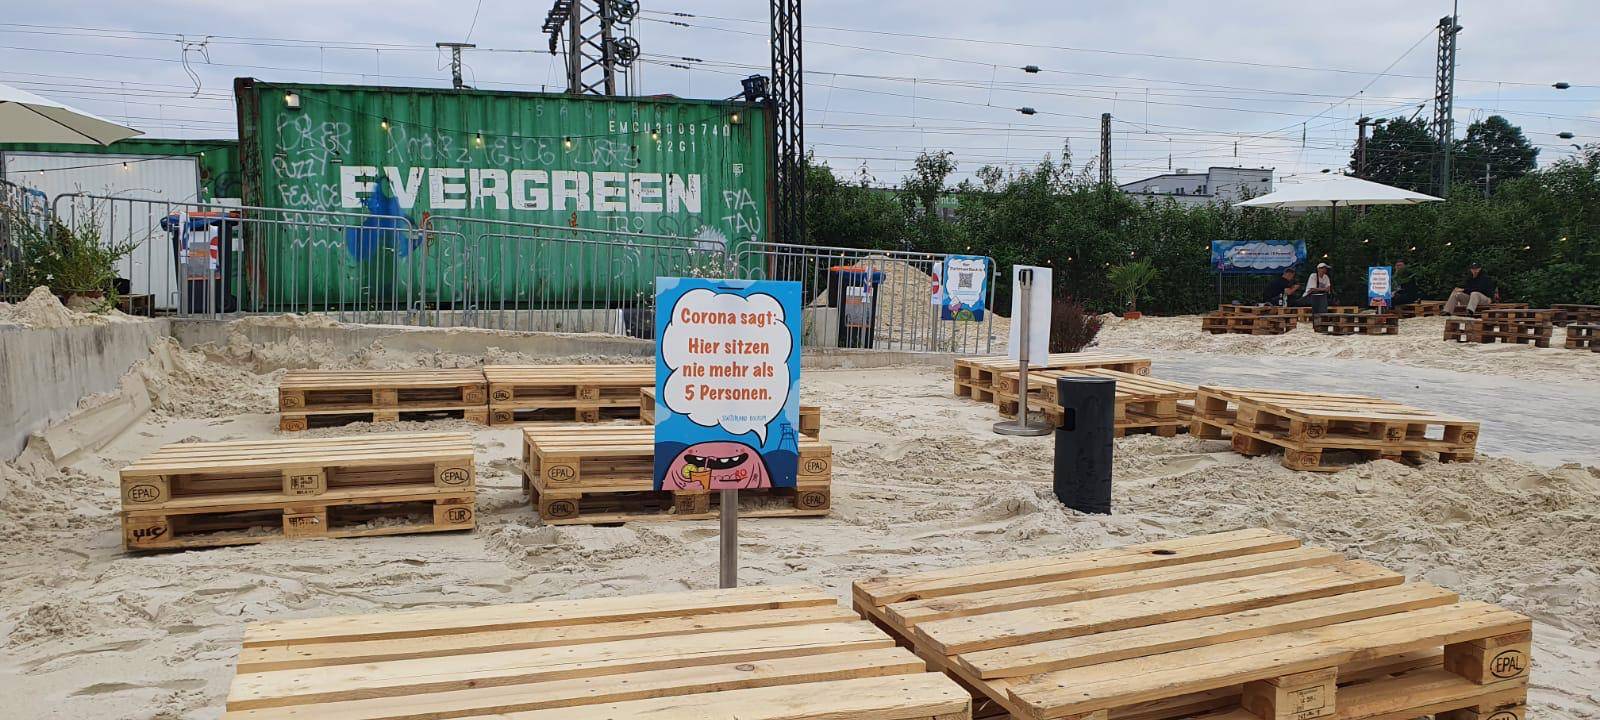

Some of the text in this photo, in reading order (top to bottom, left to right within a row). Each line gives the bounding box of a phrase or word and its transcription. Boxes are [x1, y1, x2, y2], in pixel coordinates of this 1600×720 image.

[656, 139, 696, 153] 22G1
[340, 165, 701, 213] EVERGREEN
[681, 307, 778, 328] Corona sagt:
[688, 337, 770, 355] Hier sitzen
[682, 362, 774, 377] nie mehr als
[684, 383, 772, 401] 5 Personen.
[444, 471, 466, 481] EPAL
[551, 468, 573, 478] EPAL
[132, 488, 156, 499] EPAL
[448, 510, 467, 521] EUR
[1496, 655, 1522, 673] EPAL
